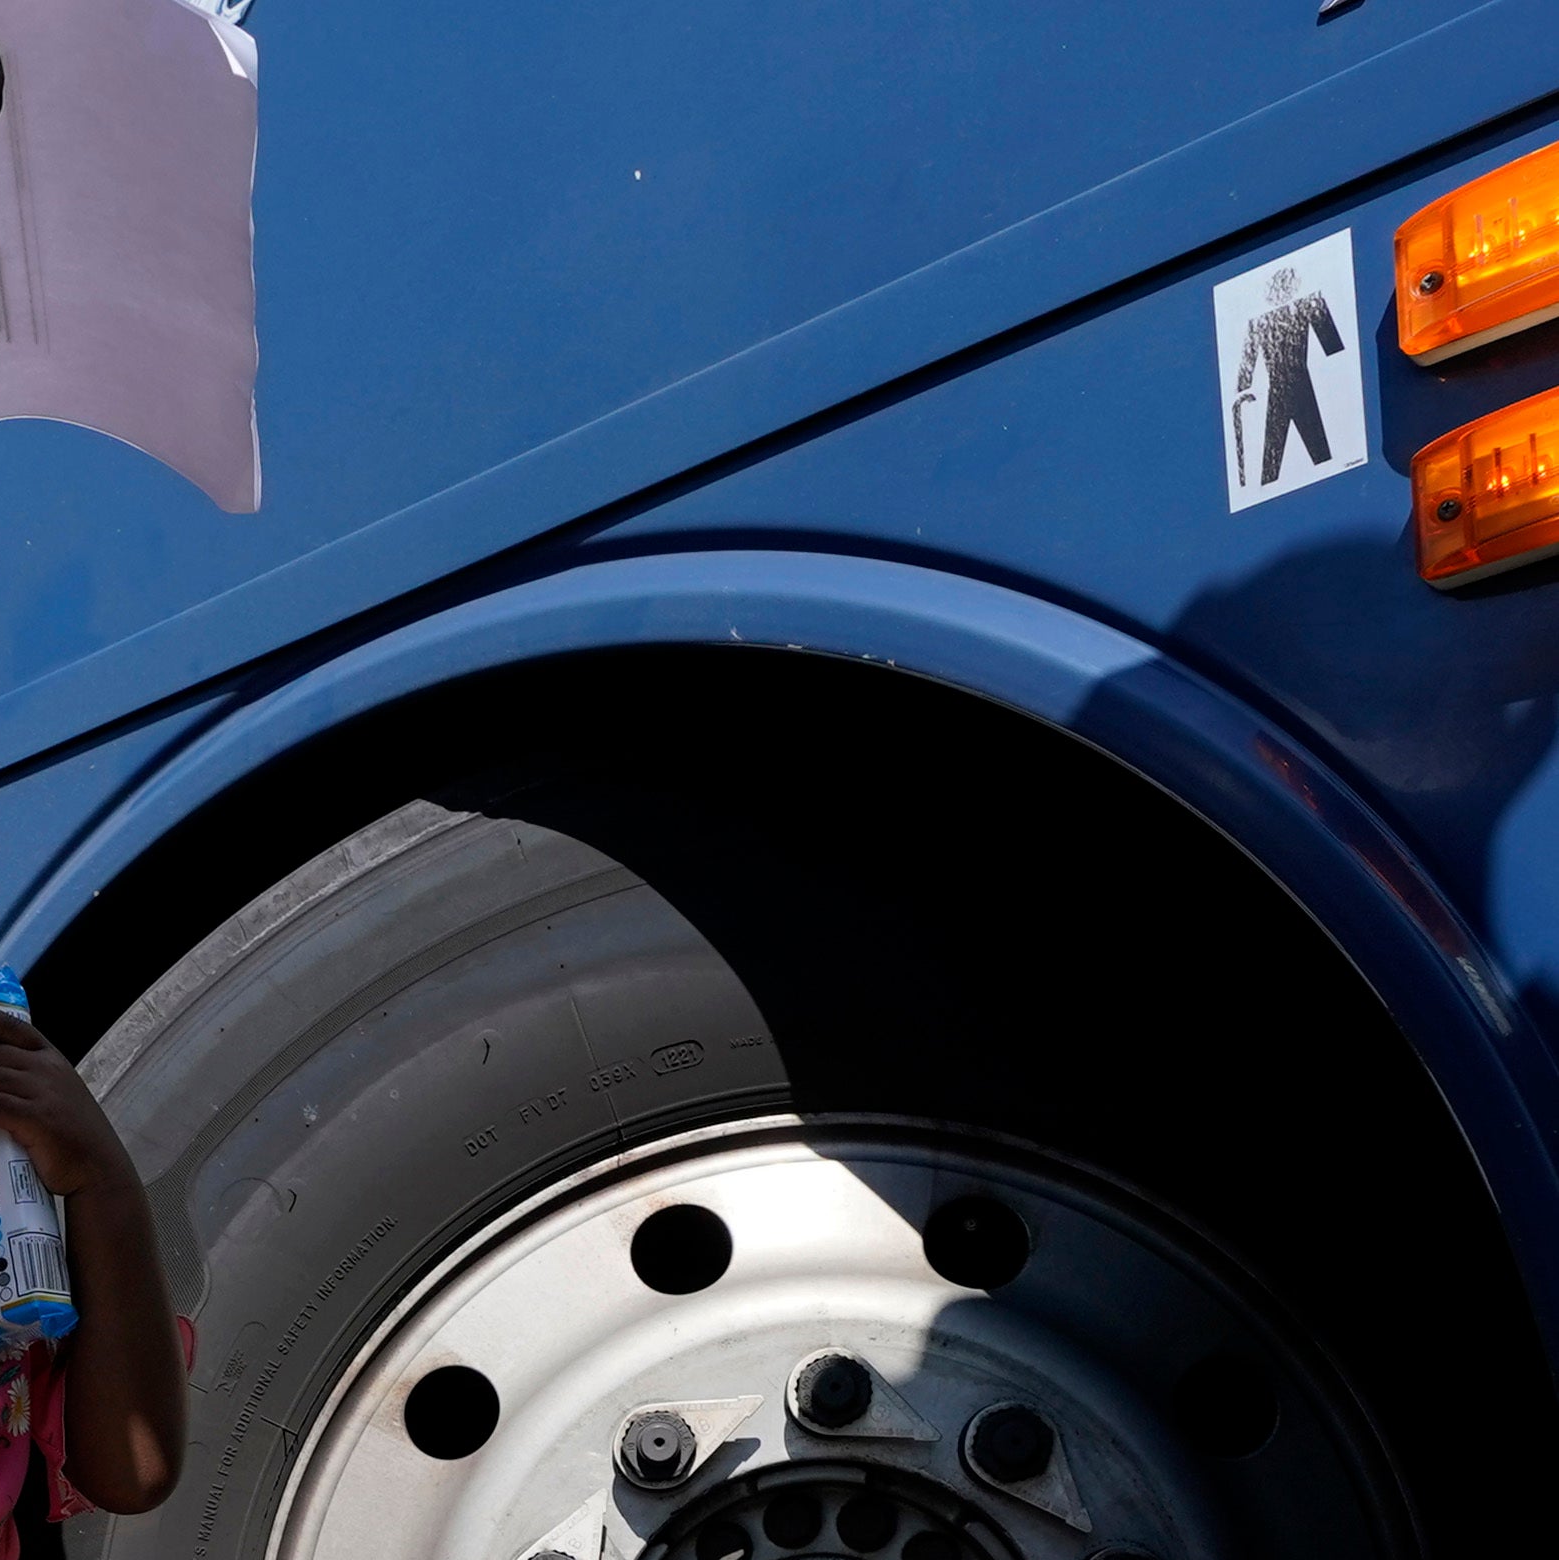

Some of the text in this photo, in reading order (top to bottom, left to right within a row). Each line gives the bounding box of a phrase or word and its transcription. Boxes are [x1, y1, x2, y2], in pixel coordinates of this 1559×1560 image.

[197, 1476, 226, 1542] MANUAL
[217, 1443, 239, 1480] FOR
[231, 1359, 283, 1446] ADDITIONAL
[277, 1299, 319, 1356] SAFETY
